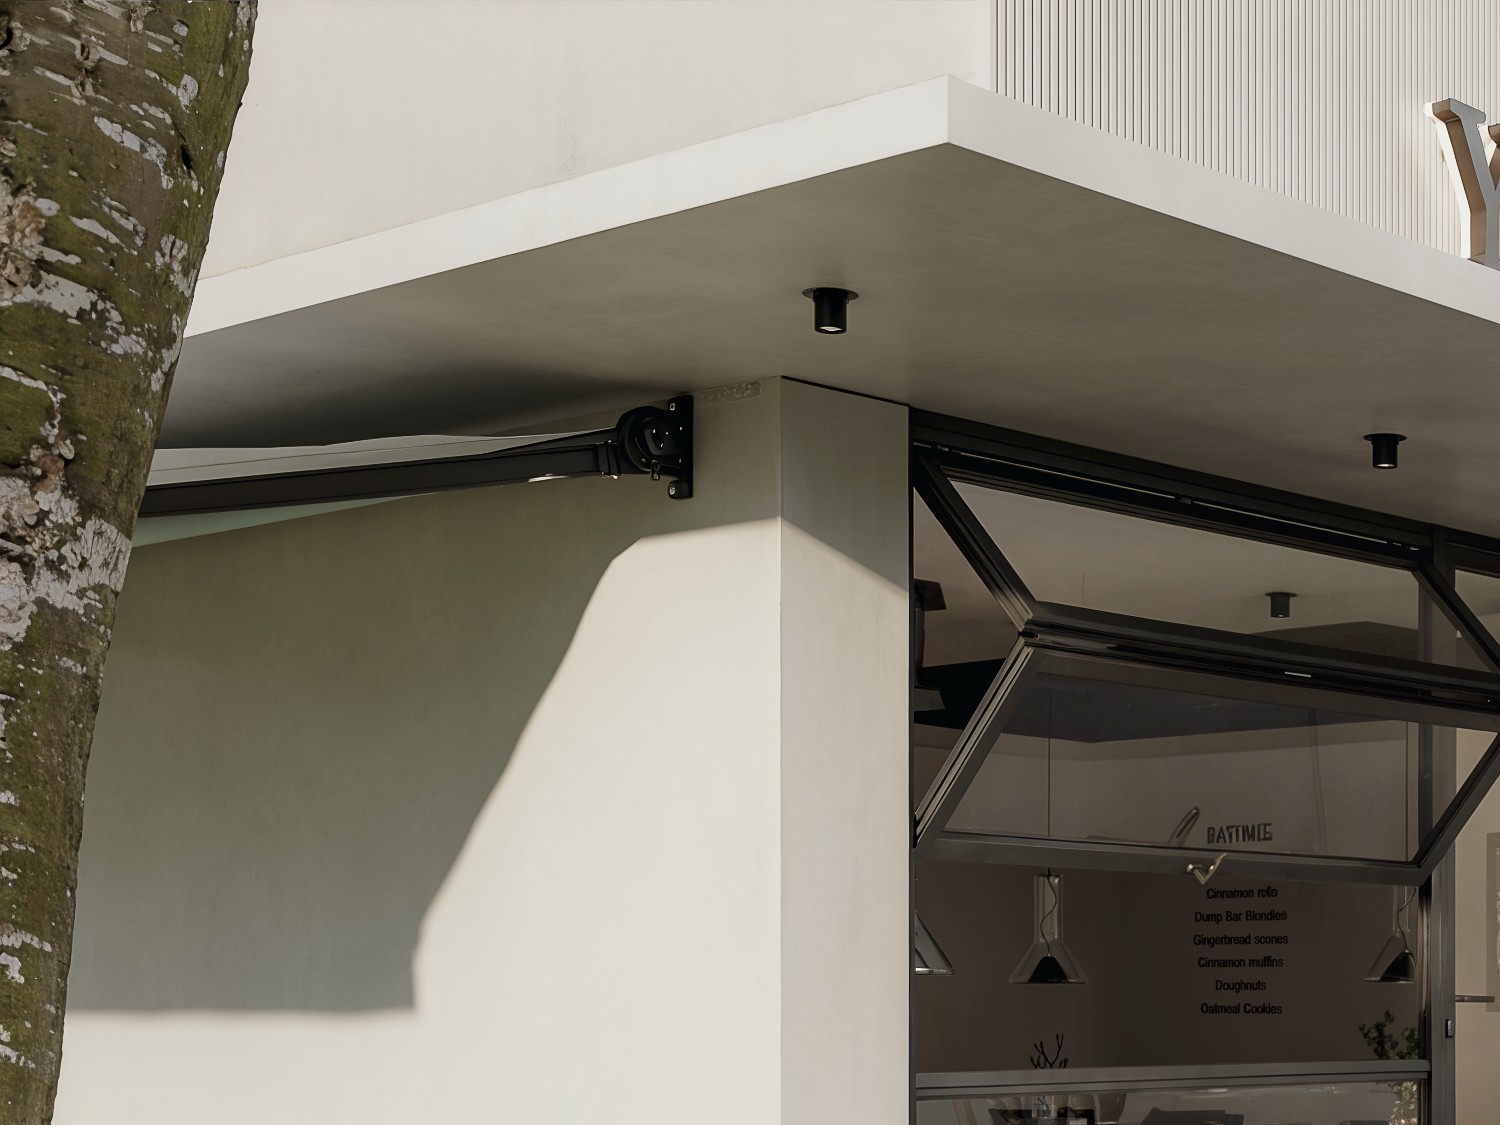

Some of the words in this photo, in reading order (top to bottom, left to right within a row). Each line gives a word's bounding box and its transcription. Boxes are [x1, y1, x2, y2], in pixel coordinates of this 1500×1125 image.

[1206, 888, 1254, 900] Cinnamon
[1194, 911, 1223, 925] Dump
[1226, 910, 1243, 921] Bar
[1245, 909, 1288, 921] Blondies
[1193, 934, 1251, 948] Gingerbread
[1254, 935, 1289, 945] scones
[1197, 956, 1246, 968] Cinnamon
[1248, 956, 1284, 968] muffins
[1215, 979, 1267, 993] Doughnuts
[1200, 1003, 1240, 1014] Oatmeal
[1243, 1003, 1283, 1014] Cookies
